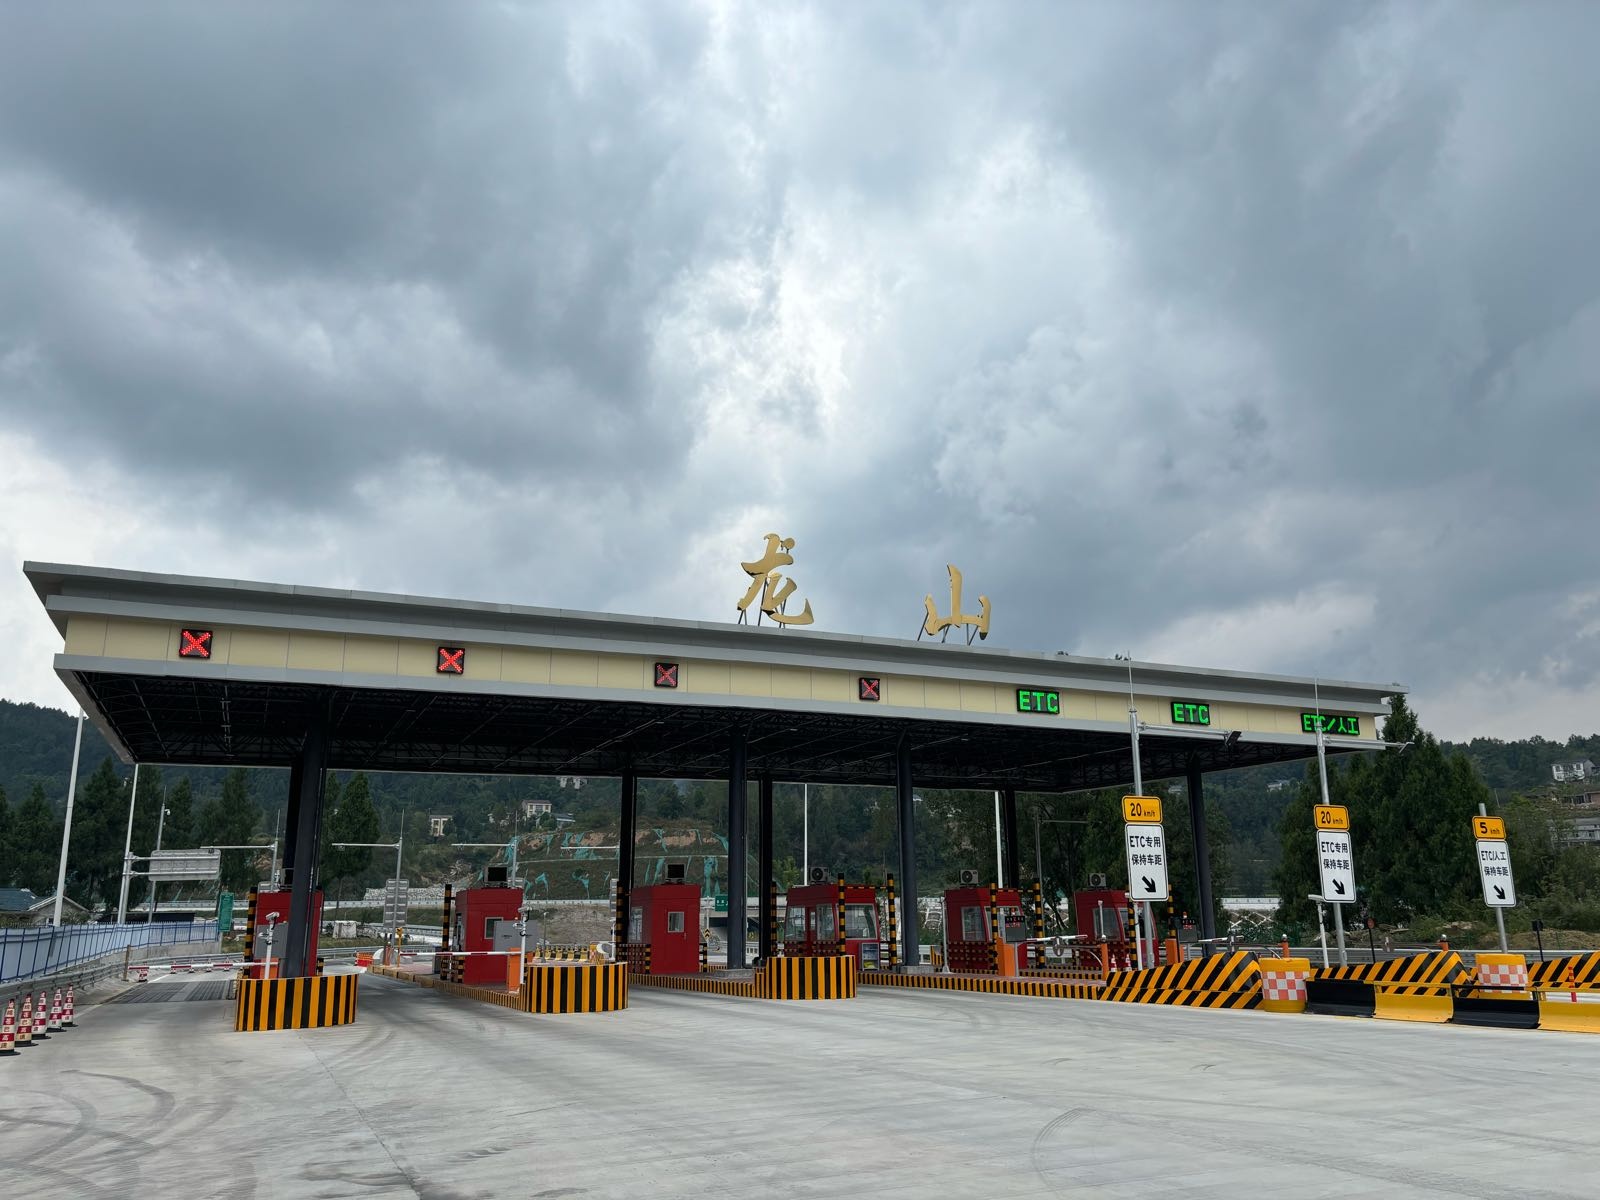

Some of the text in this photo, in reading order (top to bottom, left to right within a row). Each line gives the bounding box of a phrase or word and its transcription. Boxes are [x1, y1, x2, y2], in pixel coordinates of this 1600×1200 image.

[1019, 690, 1058, 713] ETC
[1173, 703, 1209, 724] ETC
[1130, 803, 1142, 817] 20
[1320, 811, 1331, 824] 20
[1479, 822, 1488, 834] 5
[1129, 835, 1161, 848] ETC专用
[1321, 841, 1348, 854] ETC专用
[1131, 854, 1162, 866] 保持车距
[1480, 850, 1506, 861] ETC/人工
[1323, 858, 1350, 870] 保持车距
[1483, 866, 1509, 876] 保持车距
